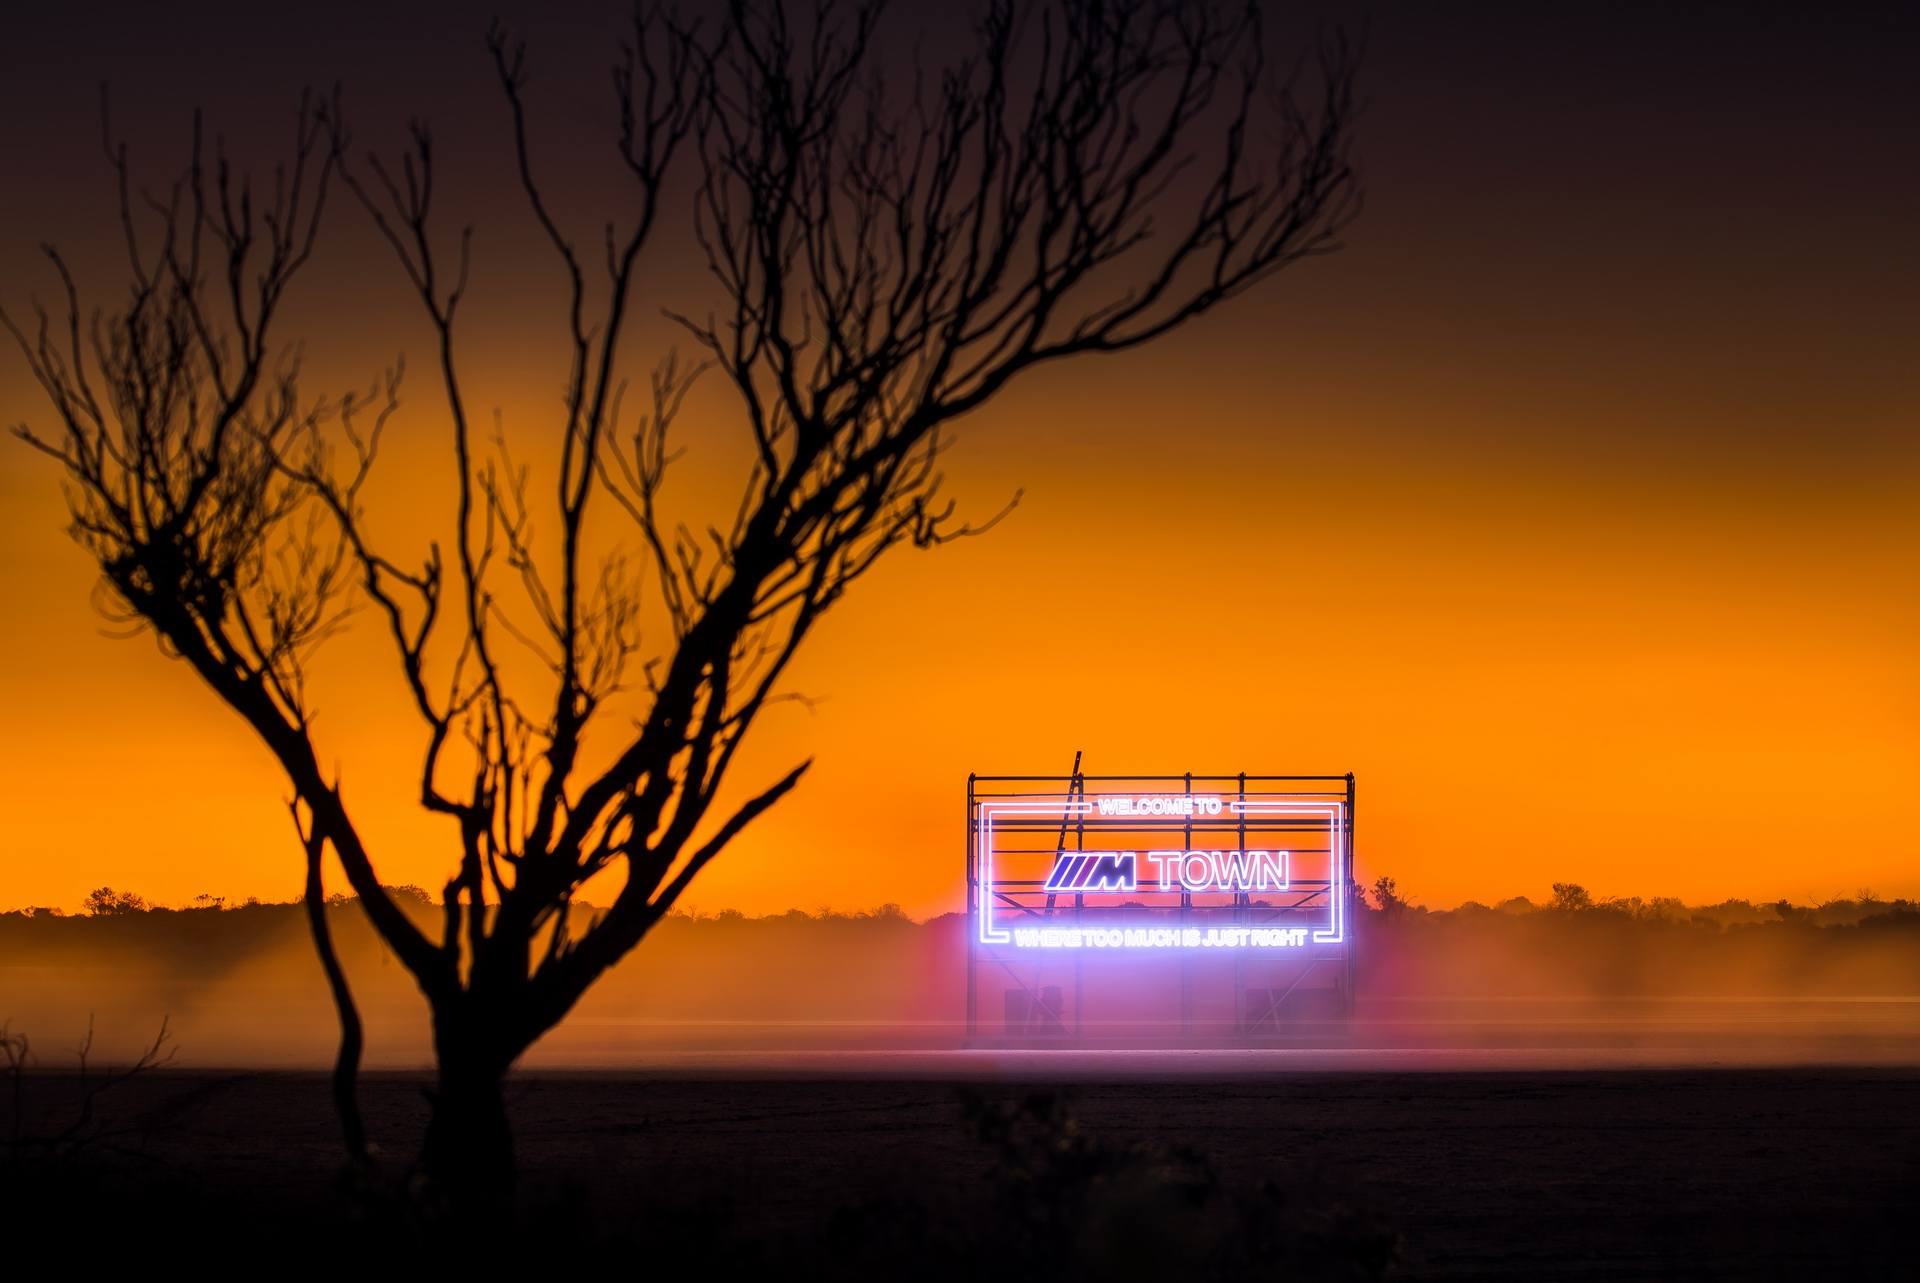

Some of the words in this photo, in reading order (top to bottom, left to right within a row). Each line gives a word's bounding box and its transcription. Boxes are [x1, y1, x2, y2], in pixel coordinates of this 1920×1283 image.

[1098, 798, 1194, 815] WELCOME
[1194, 798, 1223, 815] TO
[1148, 852, 1289, 890] TOWN
[1014, 929, 1082, 947] WHERE
[1082, 929, 1123, 947] TOO
[1124, 929, 1181, 947] MUCH
[1182, 929, 1201, 947] IS
[1201, 929, 1250, 947] JUST
[1250, 929, 1308, 947] RIGHT
